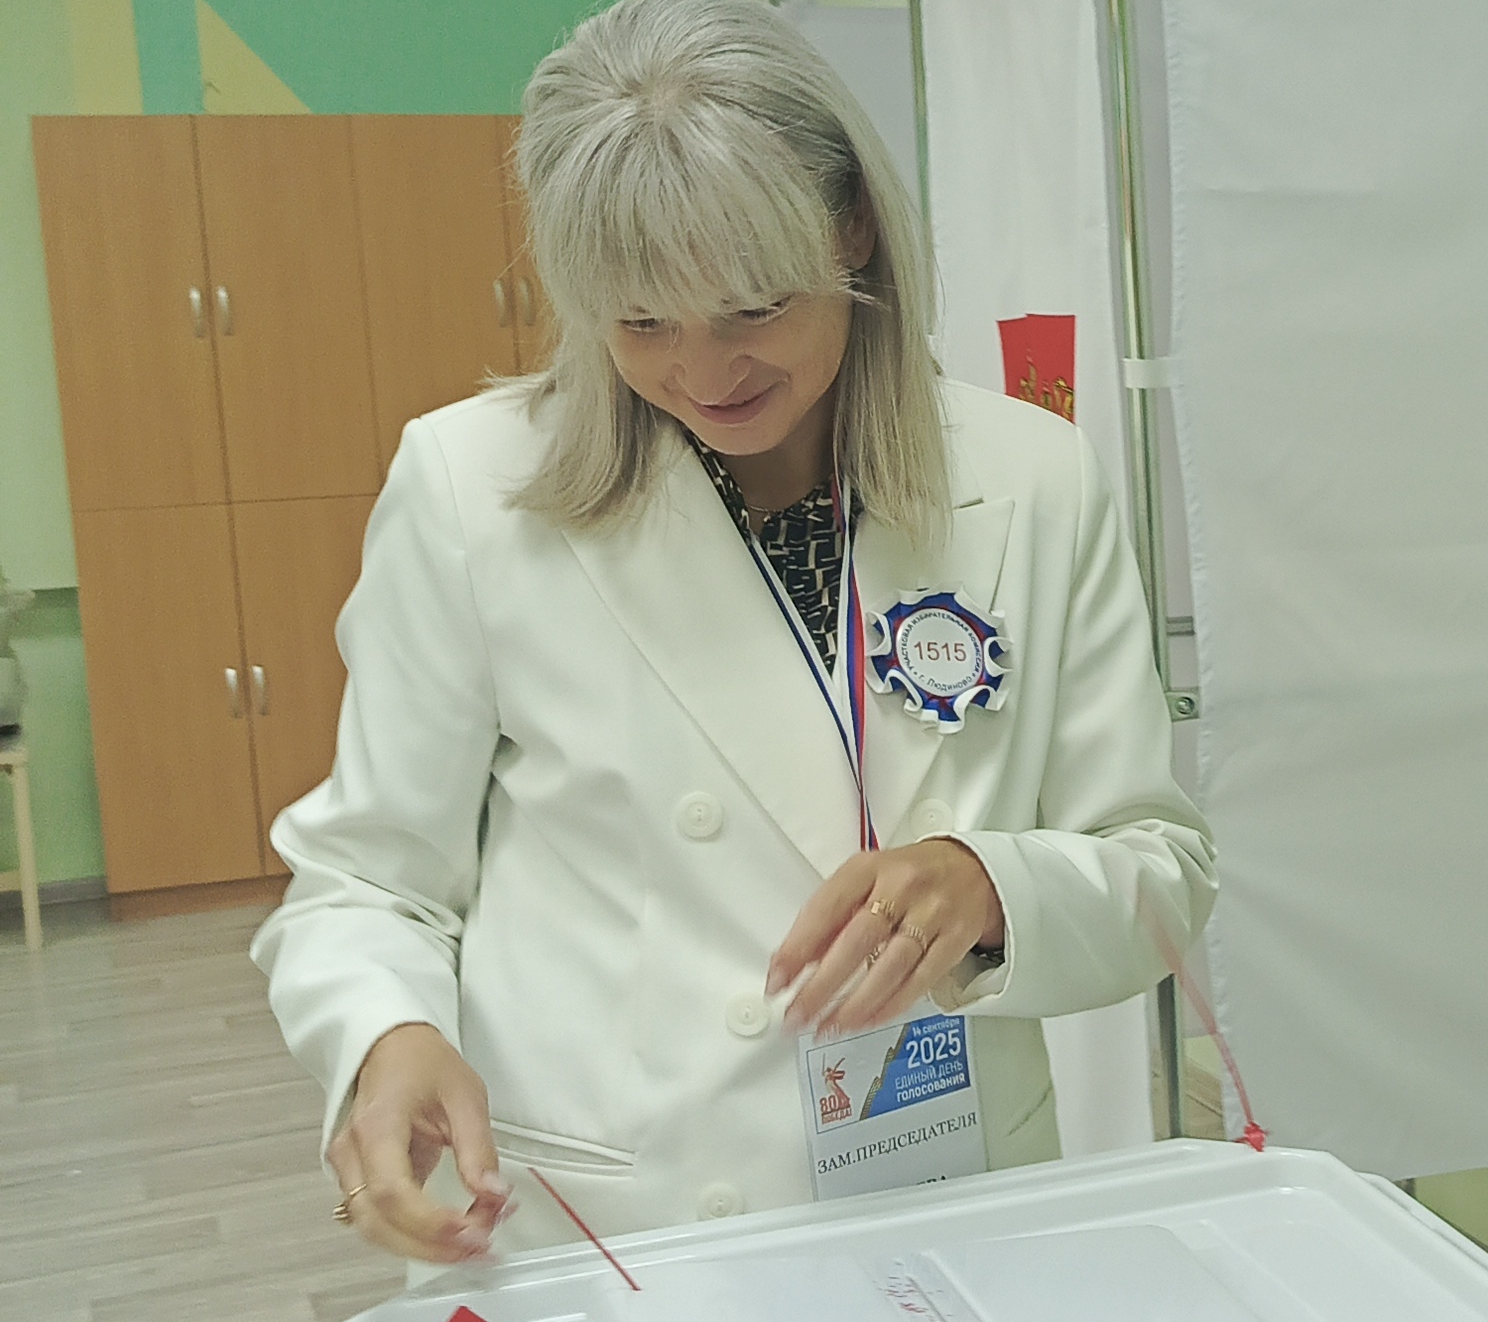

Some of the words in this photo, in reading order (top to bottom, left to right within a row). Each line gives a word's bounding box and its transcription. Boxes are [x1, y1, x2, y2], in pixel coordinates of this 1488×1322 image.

[914, 641, 967, 662] 1515
[922, 1018, 960, 1034] сентября
[906, 1028, 962, 1069] 2025
[895, 1065, 937, 1090] ЕДИНЫЙ
[938, 1060, 964, 1079] ДЕНЬ
[897, 1072, 966, 1103] голосования
[820, 1094, 839, 1113] 80
[817, 1111, 977, 1174] ЗАМ.ПРЕДСЕДАТЕЛЯ
